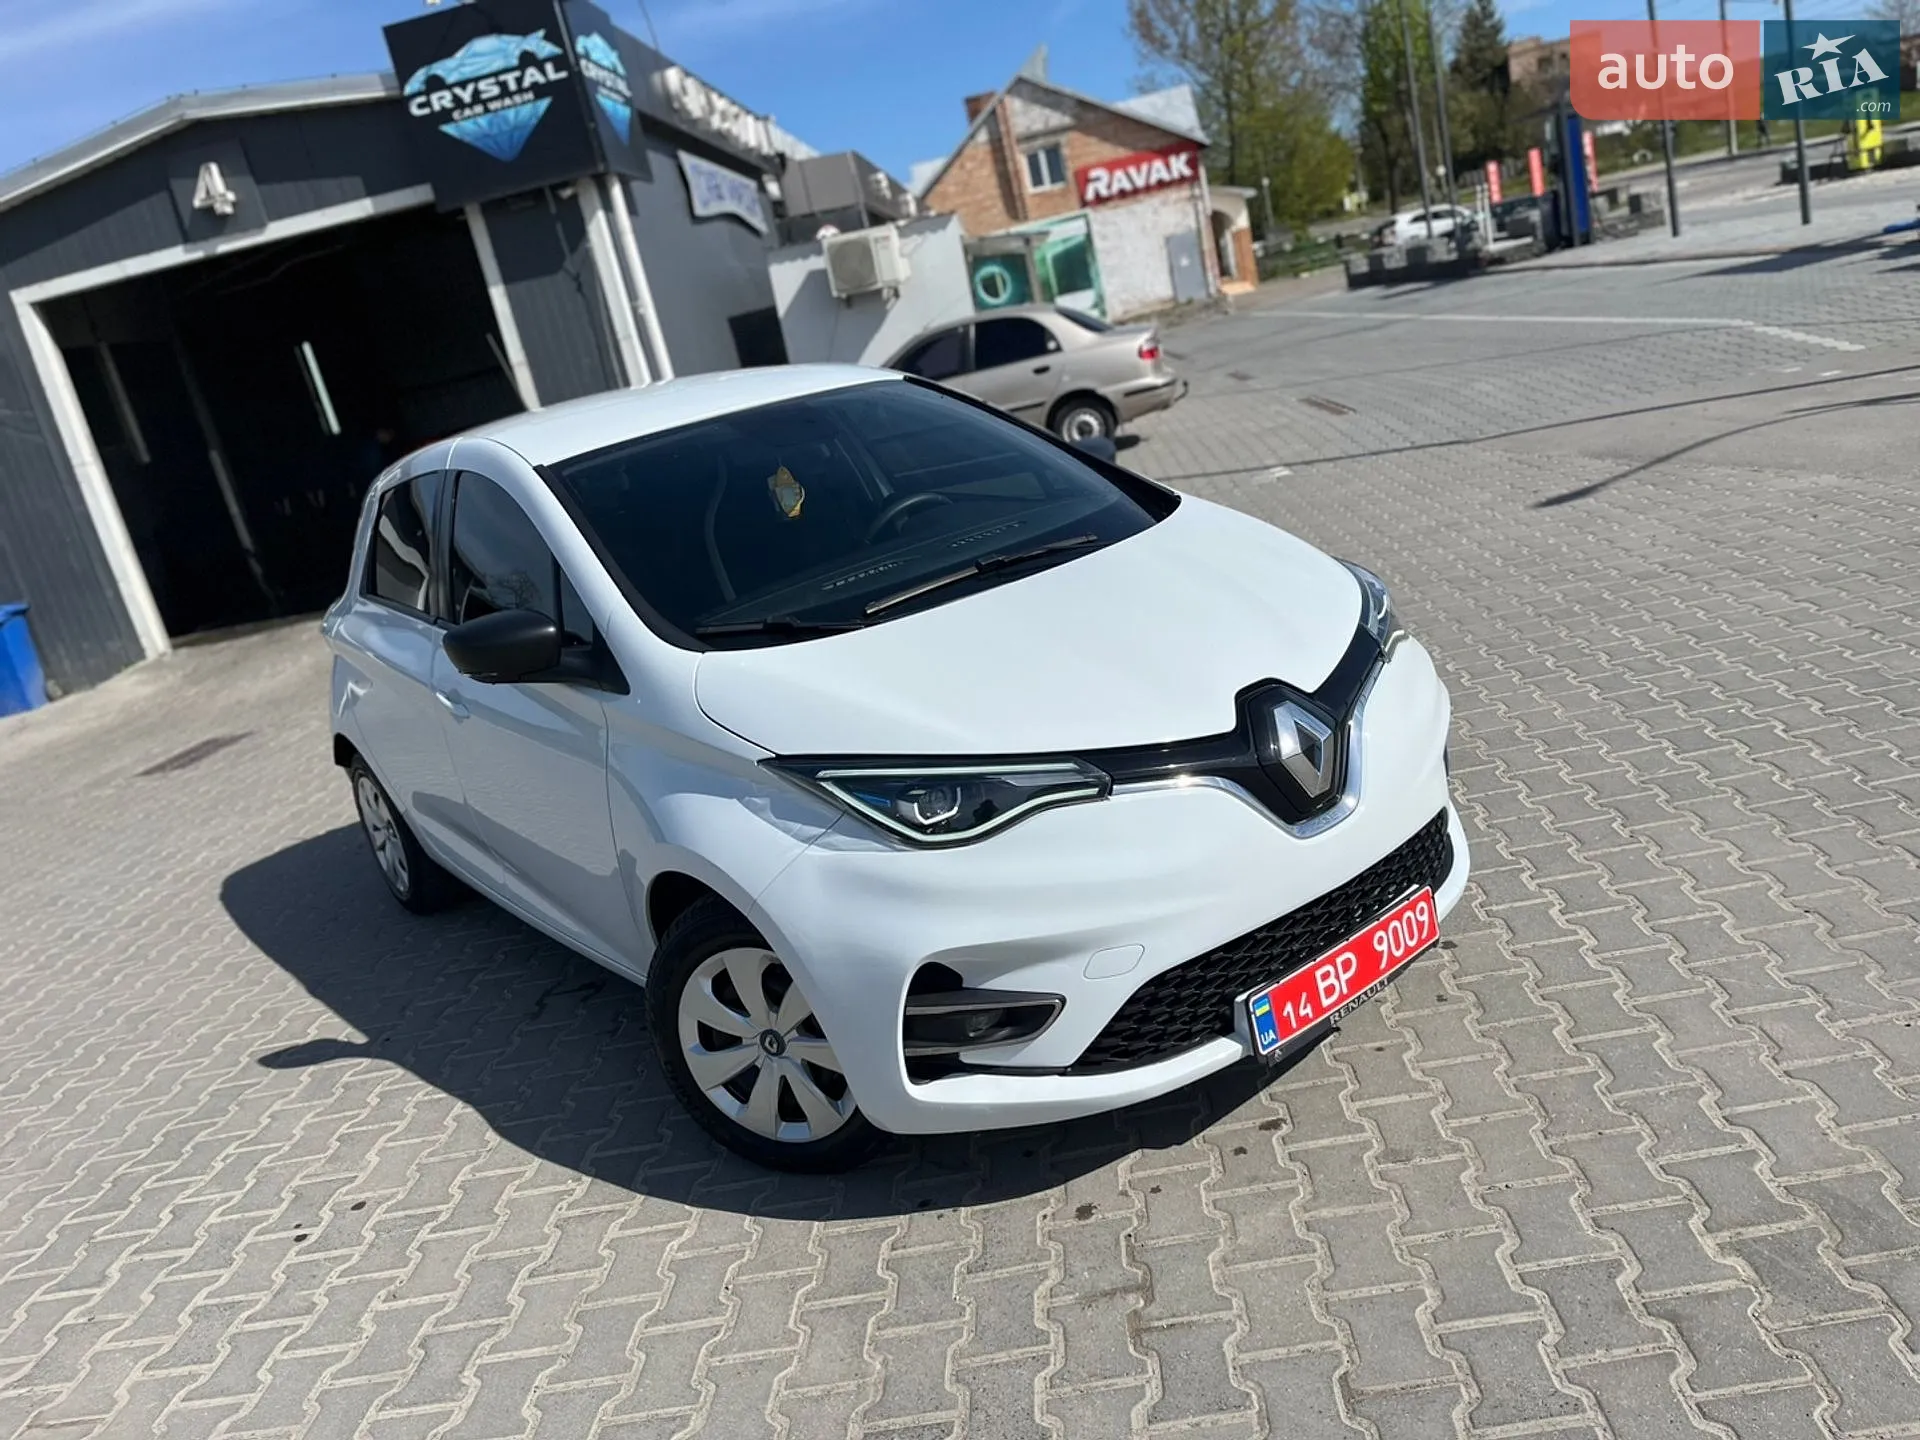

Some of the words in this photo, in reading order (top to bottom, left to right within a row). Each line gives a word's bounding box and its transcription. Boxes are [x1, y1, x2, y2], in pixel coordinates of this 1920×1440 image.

[408, 61, 569, 118] CRYSTAL
[452, 104, 485, 121] CAR
[486, 91, 535, 112] WASH
[193, 161, 236, 216] 4
[1086, 152, 1192, 200] RAVAK
[1282, 991, 1313, 1029] 14
[1314, 951, 1358, 1008] BP
[1373, 901, 1429, 969] 9009
[1260, 1028, 1277, 1045] UA
